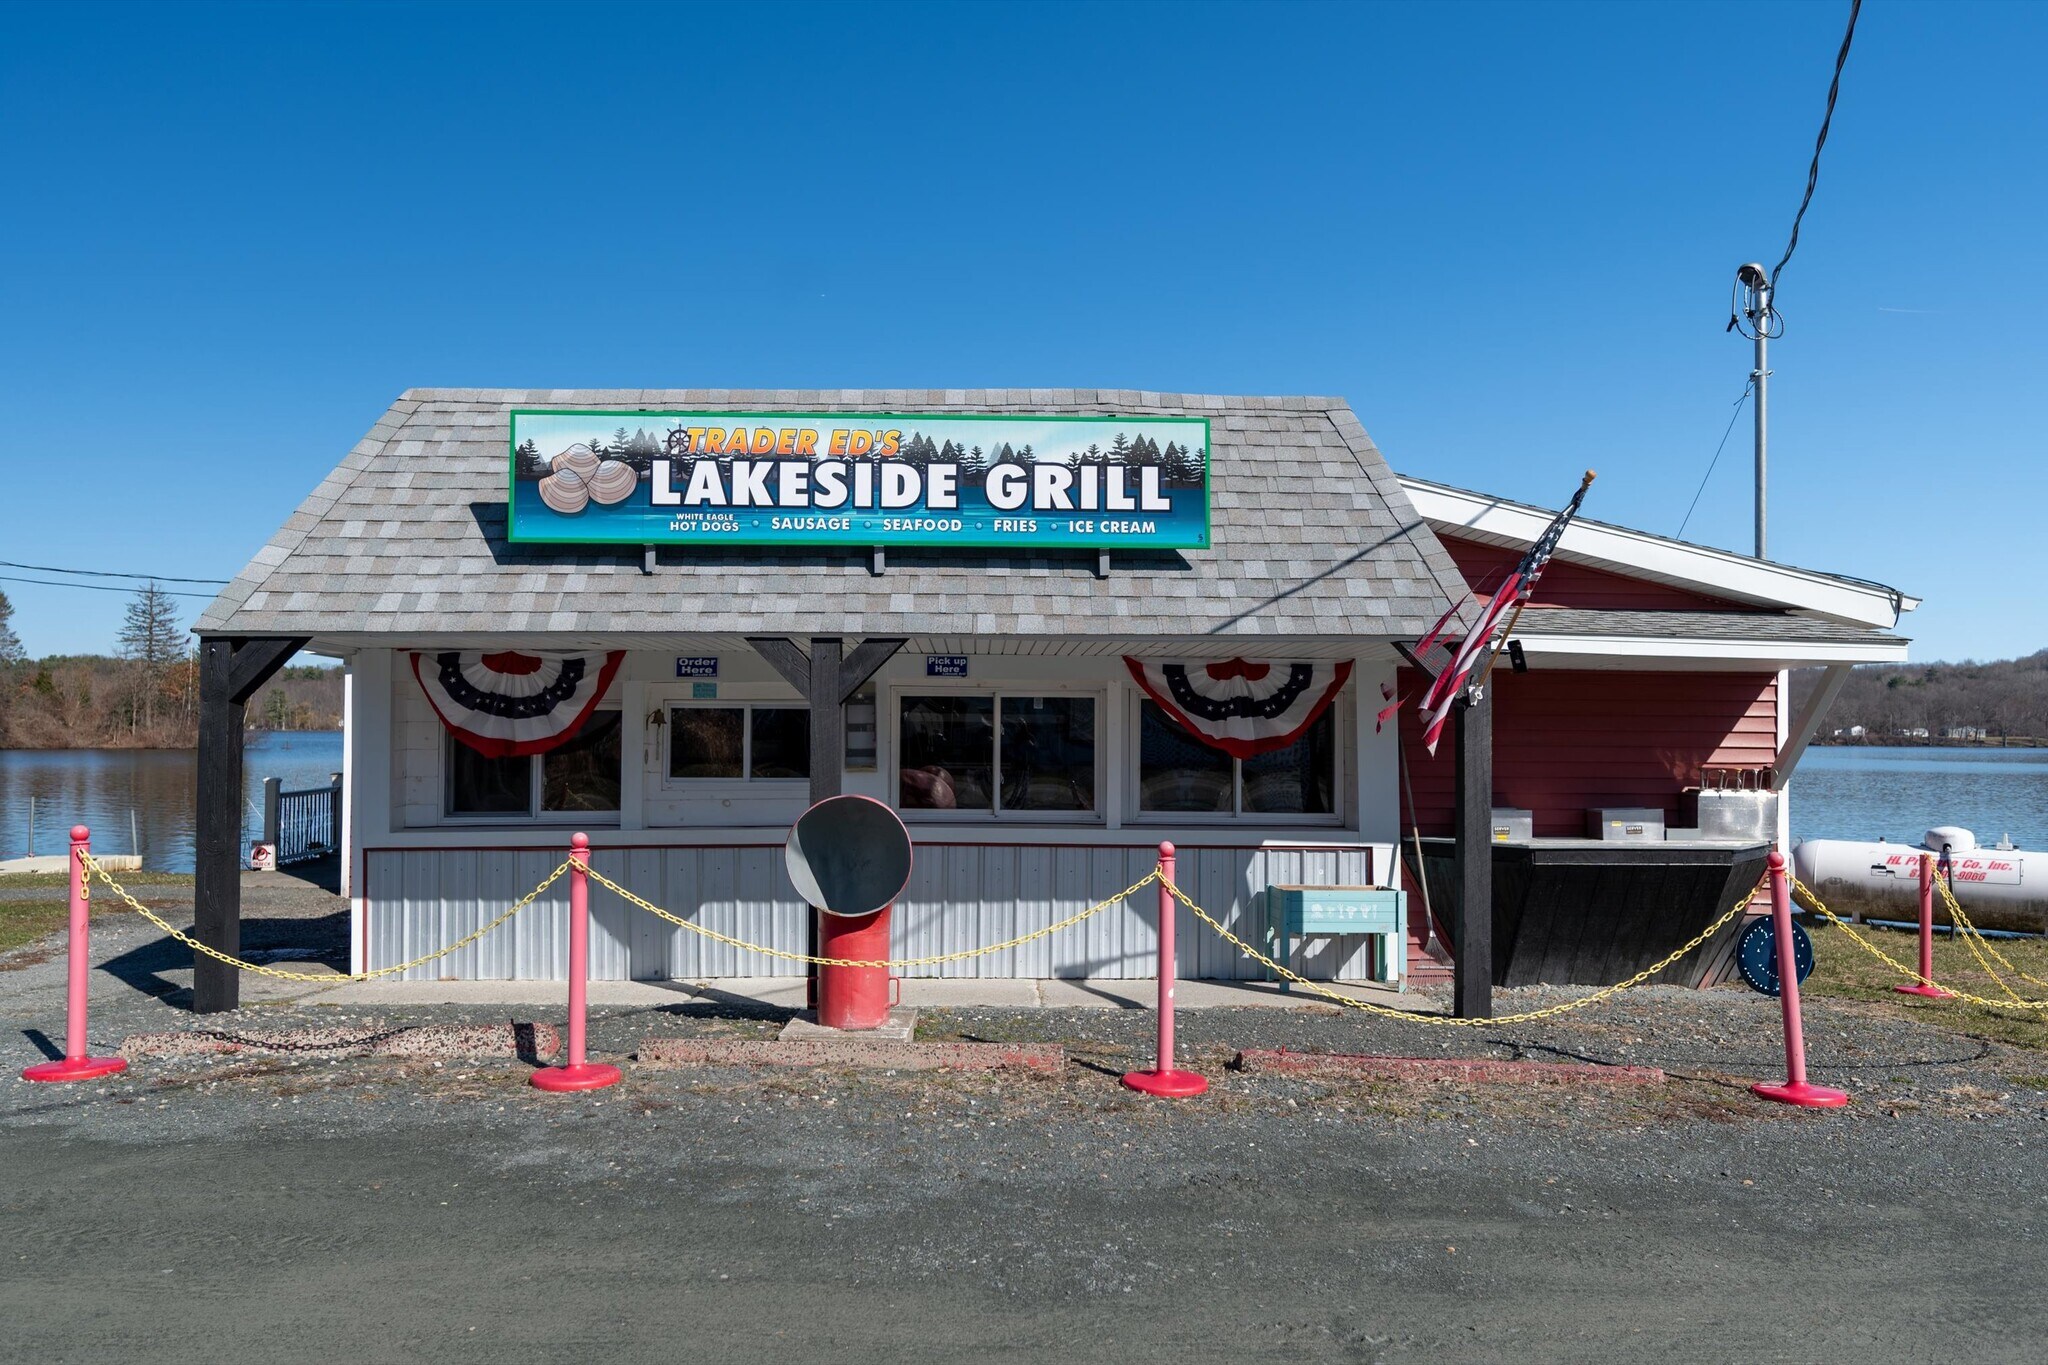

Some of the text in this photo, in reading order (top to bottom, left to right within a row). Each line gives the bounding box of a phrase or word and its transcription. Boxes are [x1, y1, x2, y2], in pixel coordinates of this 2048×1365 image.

[687, 427, 901, 456] TRADER ED'S
[651, 459, 1171, 511] LAKESIDE GRILL
[676, 513, 734, 521] WHITE EAGLE
[669, 521, 739, 532] HOT DOGS
[771, 517, 850, 531] SAUSAGE
[882, 518, 962, 532] SEAFOOD
[993, 520, 1038, 533] FRIES
[1069, 520, 1156, 534] ICE CREAM
[678, 658, 716, 666] Order
[928, 657, 967, 666] Pick up
[681, 666, 713, 674] Here
[935, 665, 960, 673] Here
[1886, 855, 1901, 865] HL
[1962, 859, 1983, 869] Co.
[1986, 860, 2013, 871] Inc.
